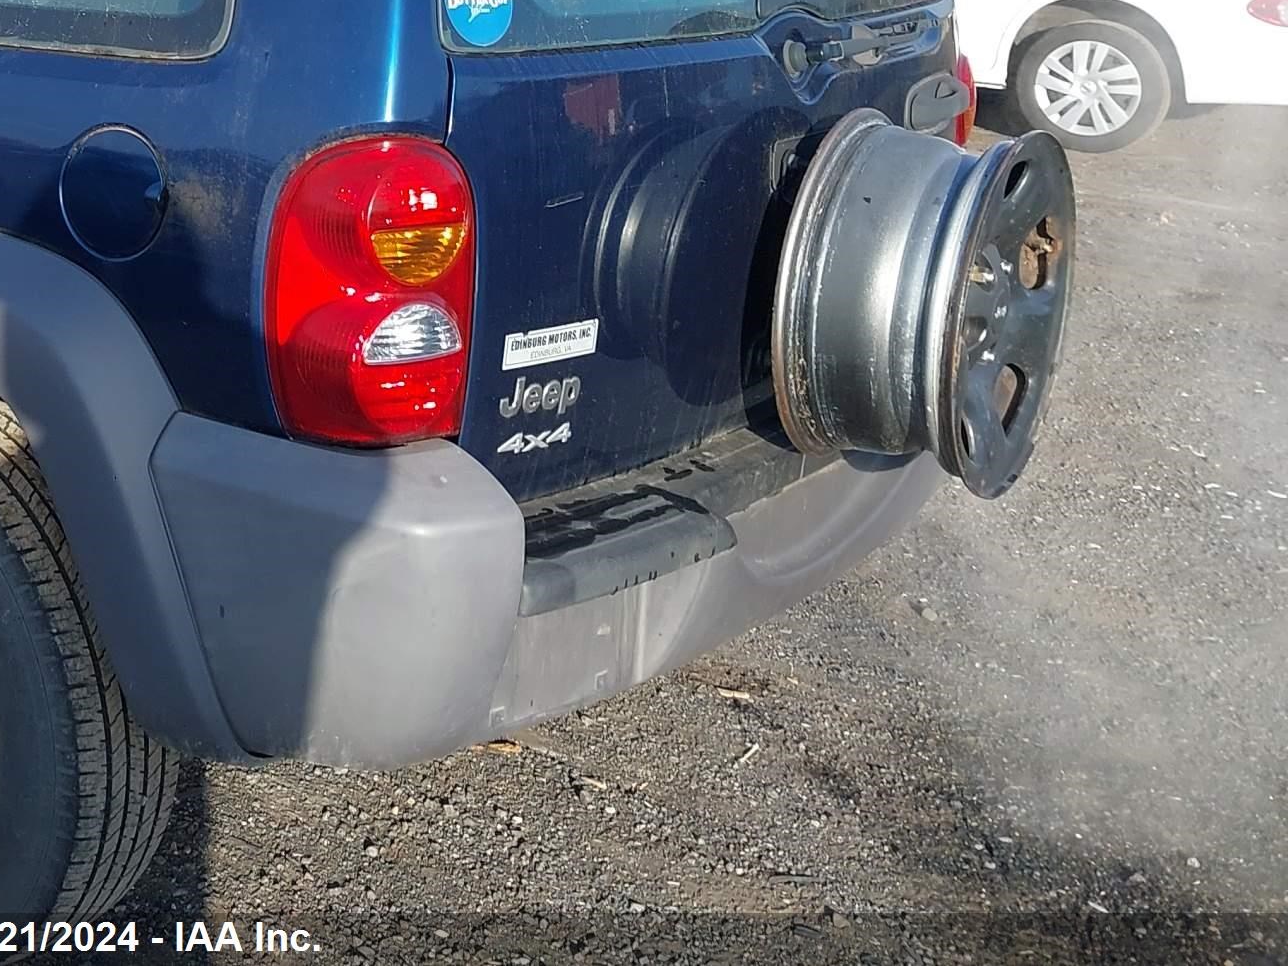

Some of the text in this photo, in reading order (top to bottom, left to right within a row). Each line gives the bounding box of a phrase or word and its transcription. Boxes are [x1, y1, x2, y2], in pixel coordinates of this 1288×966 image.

[511, 334, 547, 351] EDINBURG
[578, 326, 592, 339] INC.
[500, 376, 581, 418] Jeep
